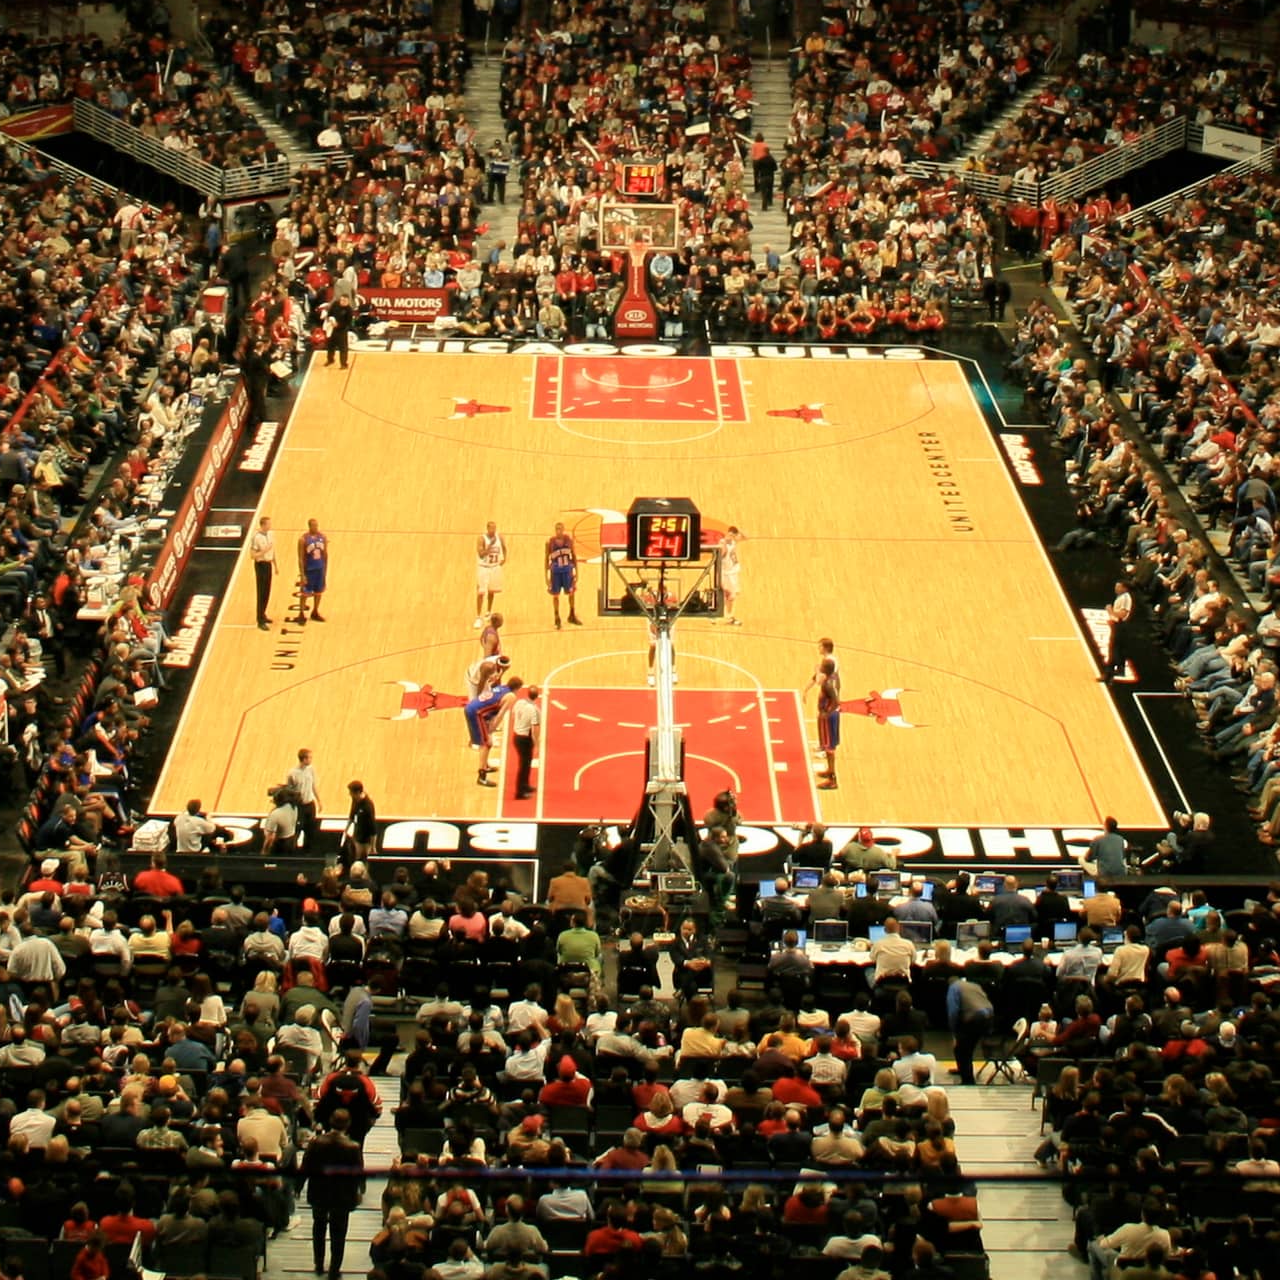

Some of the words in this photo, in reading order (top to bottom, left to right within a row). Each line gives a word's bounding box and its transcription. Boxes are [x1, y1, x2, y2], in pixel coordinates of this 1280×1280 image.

[371, 297, 392, 309] KIA
[393, 297, 442, 309] MOTORS
[349, 339, 678, 357] CHICAGO
[728, 343, 926, 361] BULLS
[917, 431, 953, 478] CENTER
[936, 480, 974, 533] UNITED
[651, 517, 688, 533] 2:51
[646, 534, 684, 558] 24
[162, 592, 216, 669] Bulls.com
